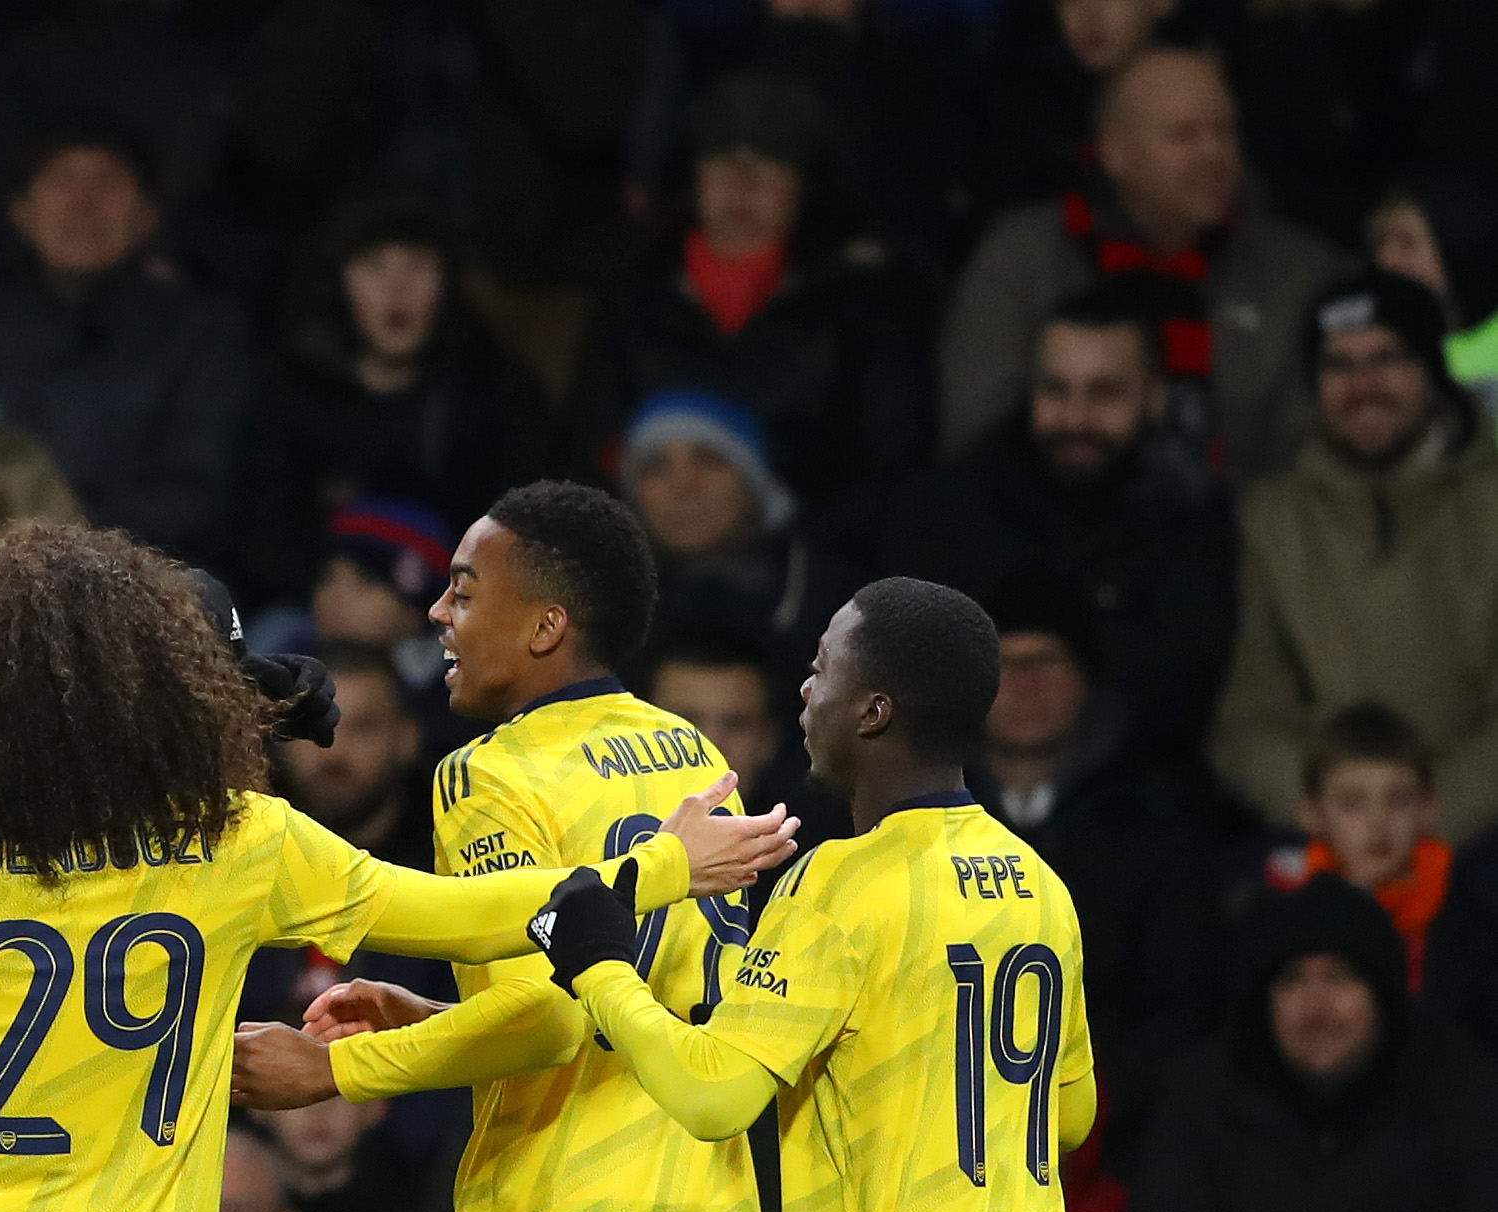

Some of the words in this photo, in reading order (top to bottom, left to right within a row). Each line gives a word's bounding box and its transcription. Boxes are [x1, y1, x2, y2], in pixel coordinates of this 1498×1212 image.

[582, 727, 714, 780] WILLOCK
[459, 831, 505, 864] VISIT
[951, 855, 1034, 899] PEPE
[945, 942, 1063, 1188] 19
